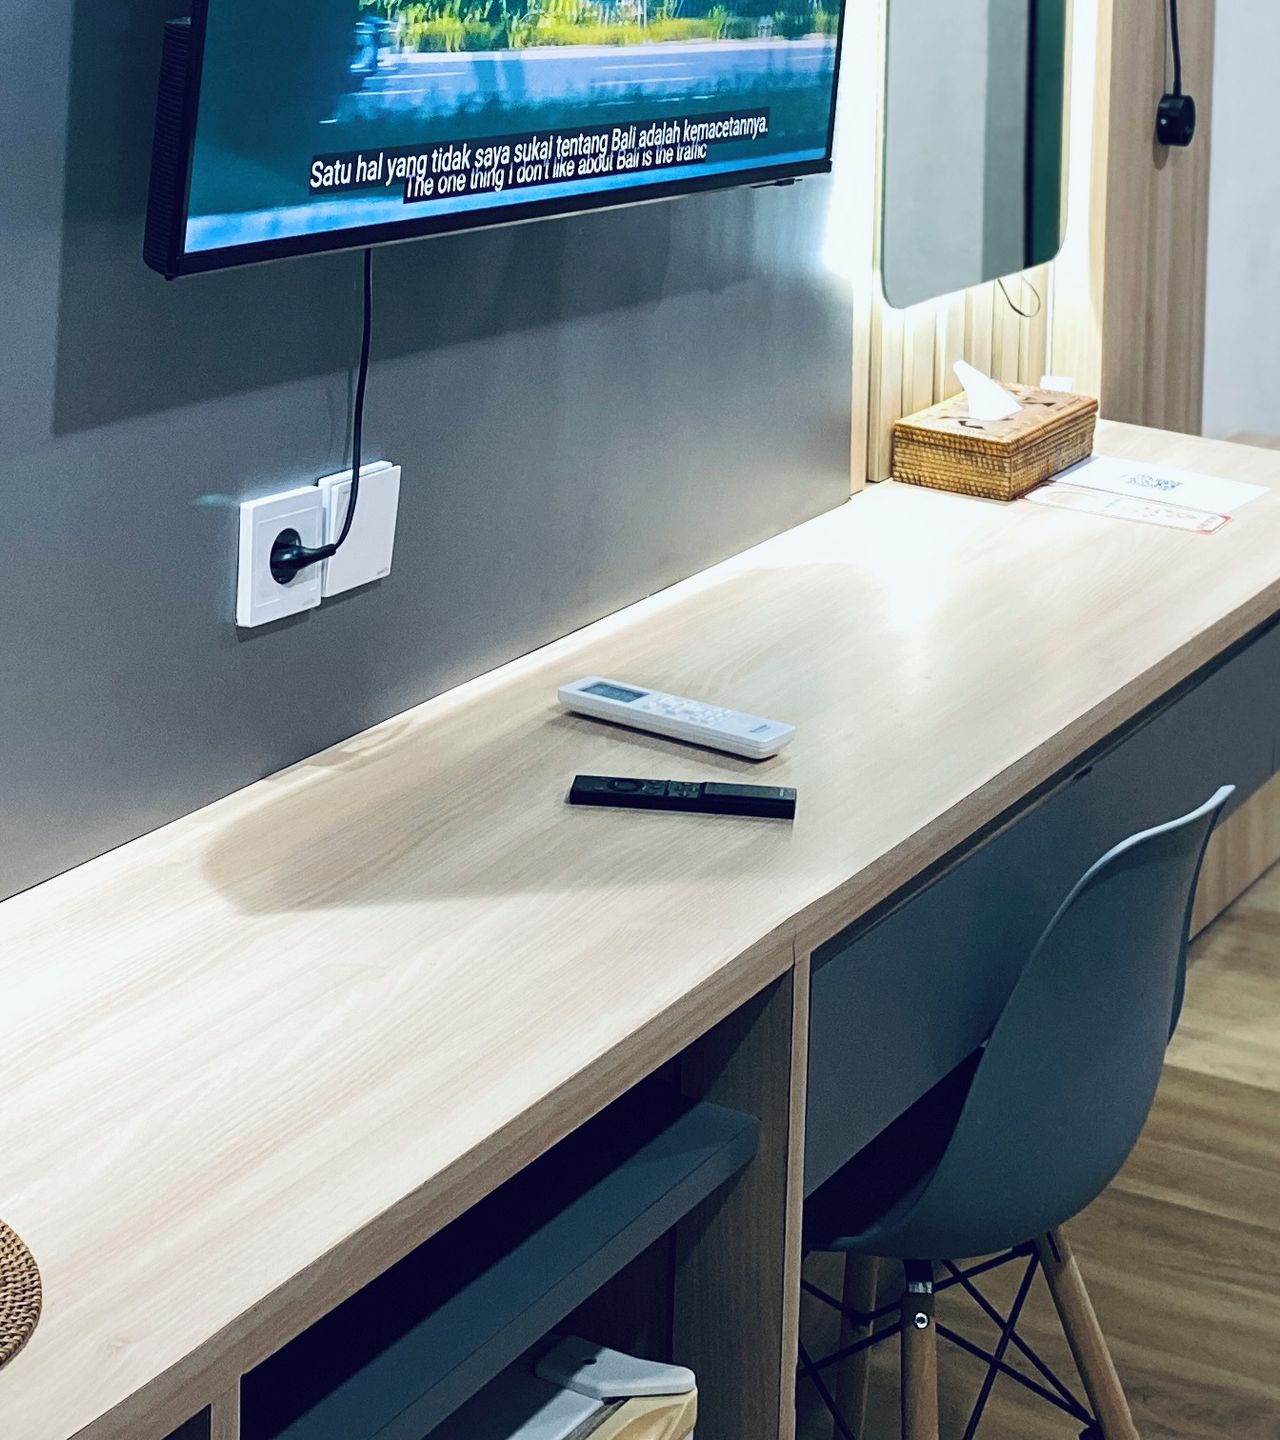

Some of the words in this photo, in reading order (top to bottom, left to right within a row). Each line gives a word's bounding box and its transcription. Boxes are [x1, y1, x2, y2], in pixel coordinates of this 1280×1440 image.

[310, 160, 352, 188] Satu
[355, 152, 384, 183] hal
[385, 154, 428, 187] yang
[432, 143, 471, 173] tidak
[474, 144, 511, 171] saya
[556, 133, 609, 159] tentang
[612, 125, 637, 151] Bali
[638, 120, 681, 148] adalah
[683, 116, 769, 143] kemacetannya.
[406, 174, 434, 198] The
[438, 172, 466, 194] one
[470, 164, 504, 192] thing
[516, 160, 550, 184] don't
[552, 157, 575, 179] like
[577, 153, 614, 175] about
[616, 146, 639, 170] Bali
[655, 143, 674, 165] the
